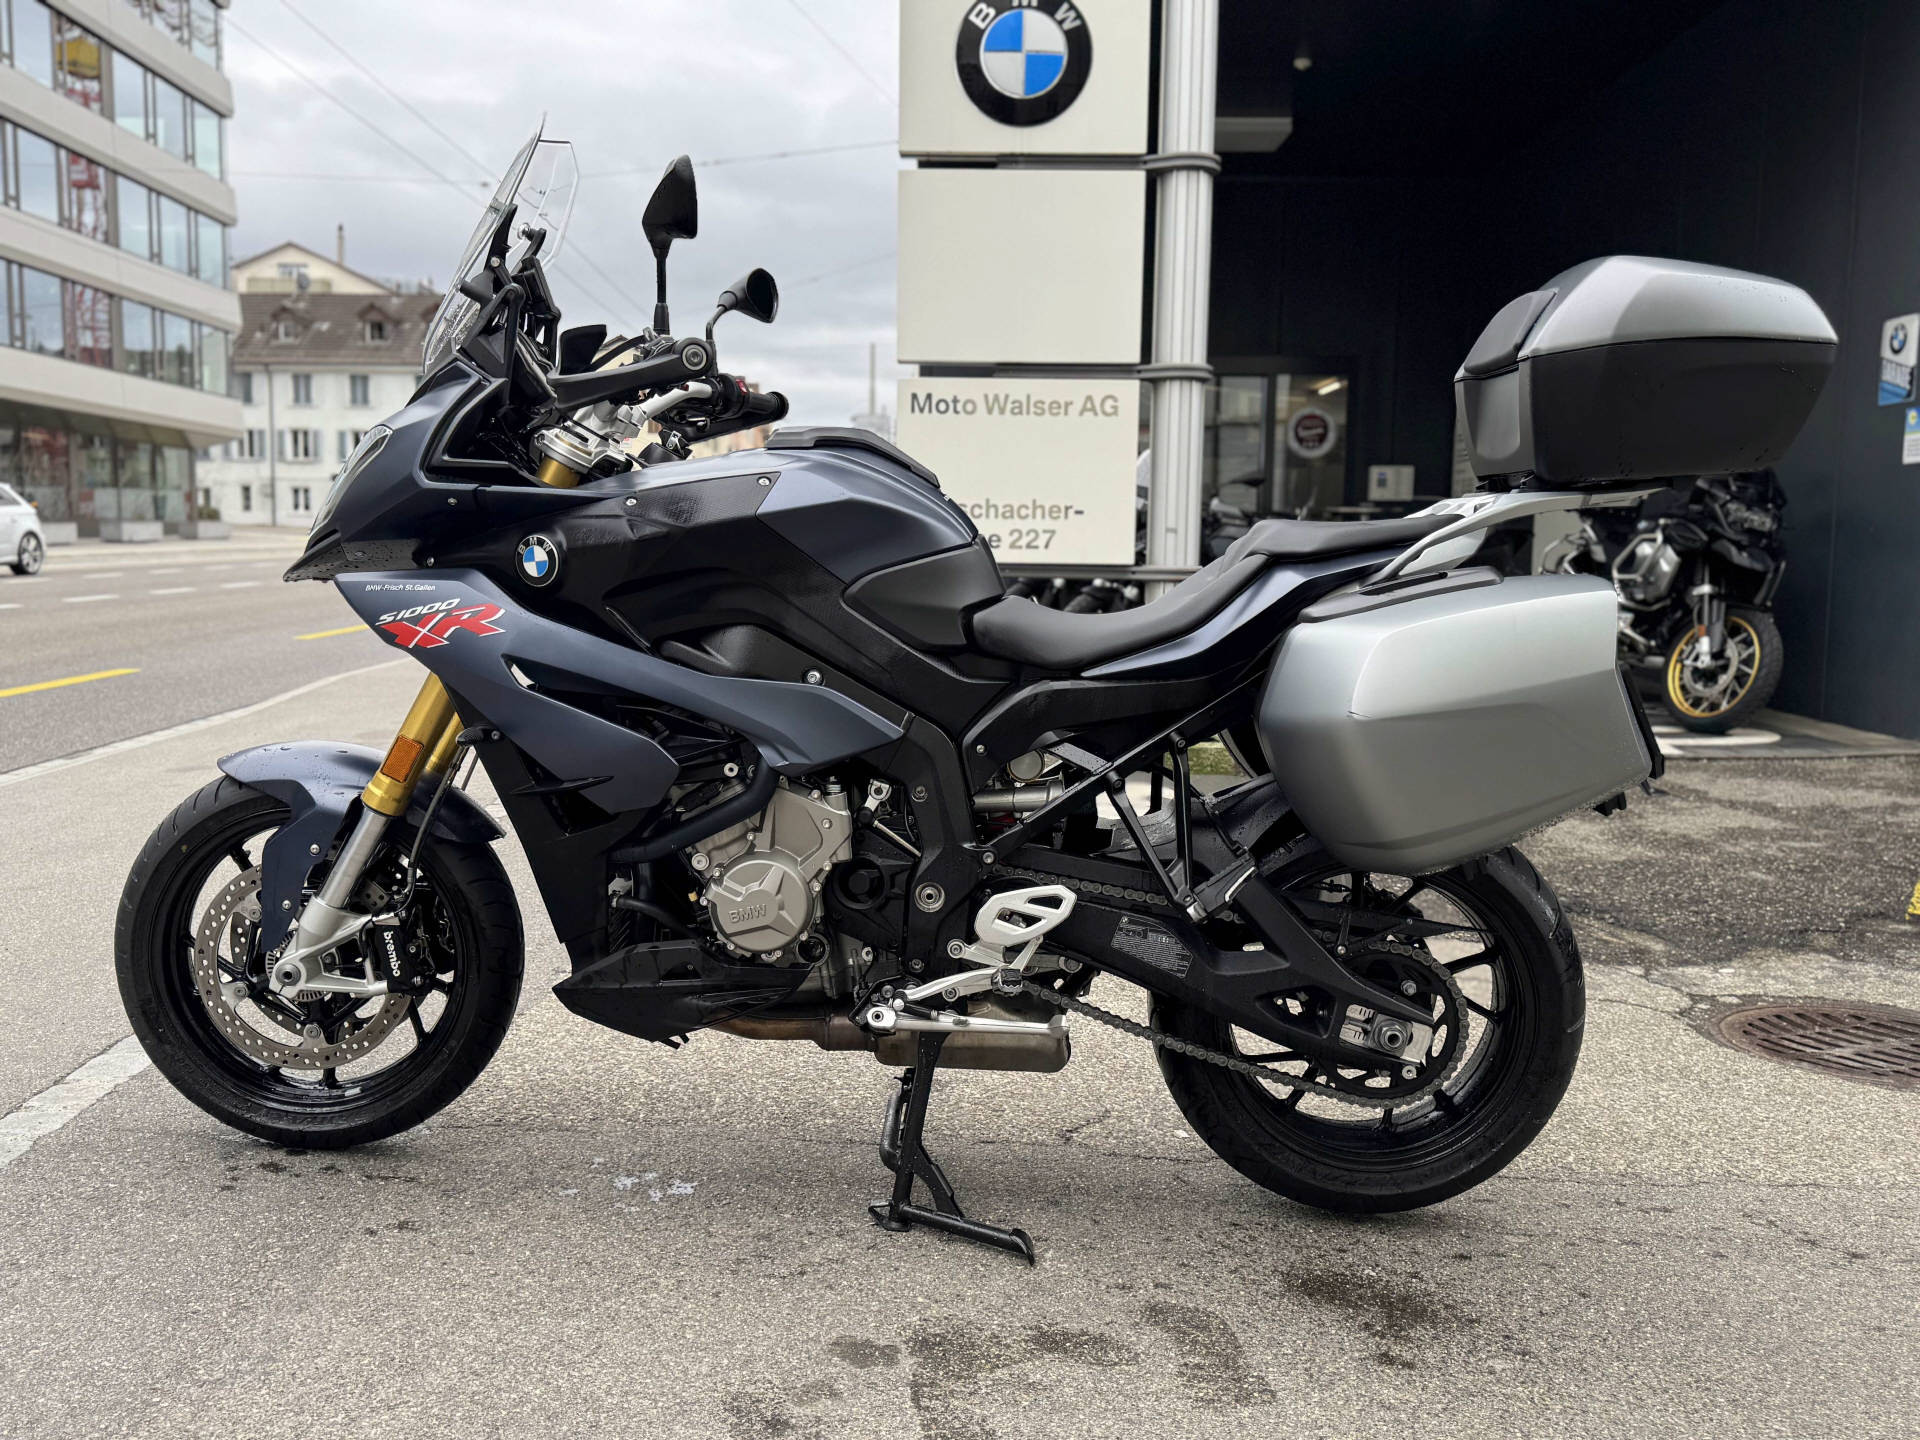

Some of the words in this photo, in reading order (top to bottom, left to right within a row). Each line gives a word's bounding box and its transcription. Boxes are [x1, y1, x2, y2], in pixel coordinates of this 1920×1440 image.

[910, 392, 977, 416] Moto
[984, 393, 1073, 417] Walser
[1078, 394, 1119, 418] AG
[518, 537, 552, 554] BMW
[1008, 528, 1056, 550] 227
[375, 598, 460, 625] S1000
[380, 603, 507, 648] XR
[728, 903, 767, 924] BMW
[382, 930, 402, 978] brembo
